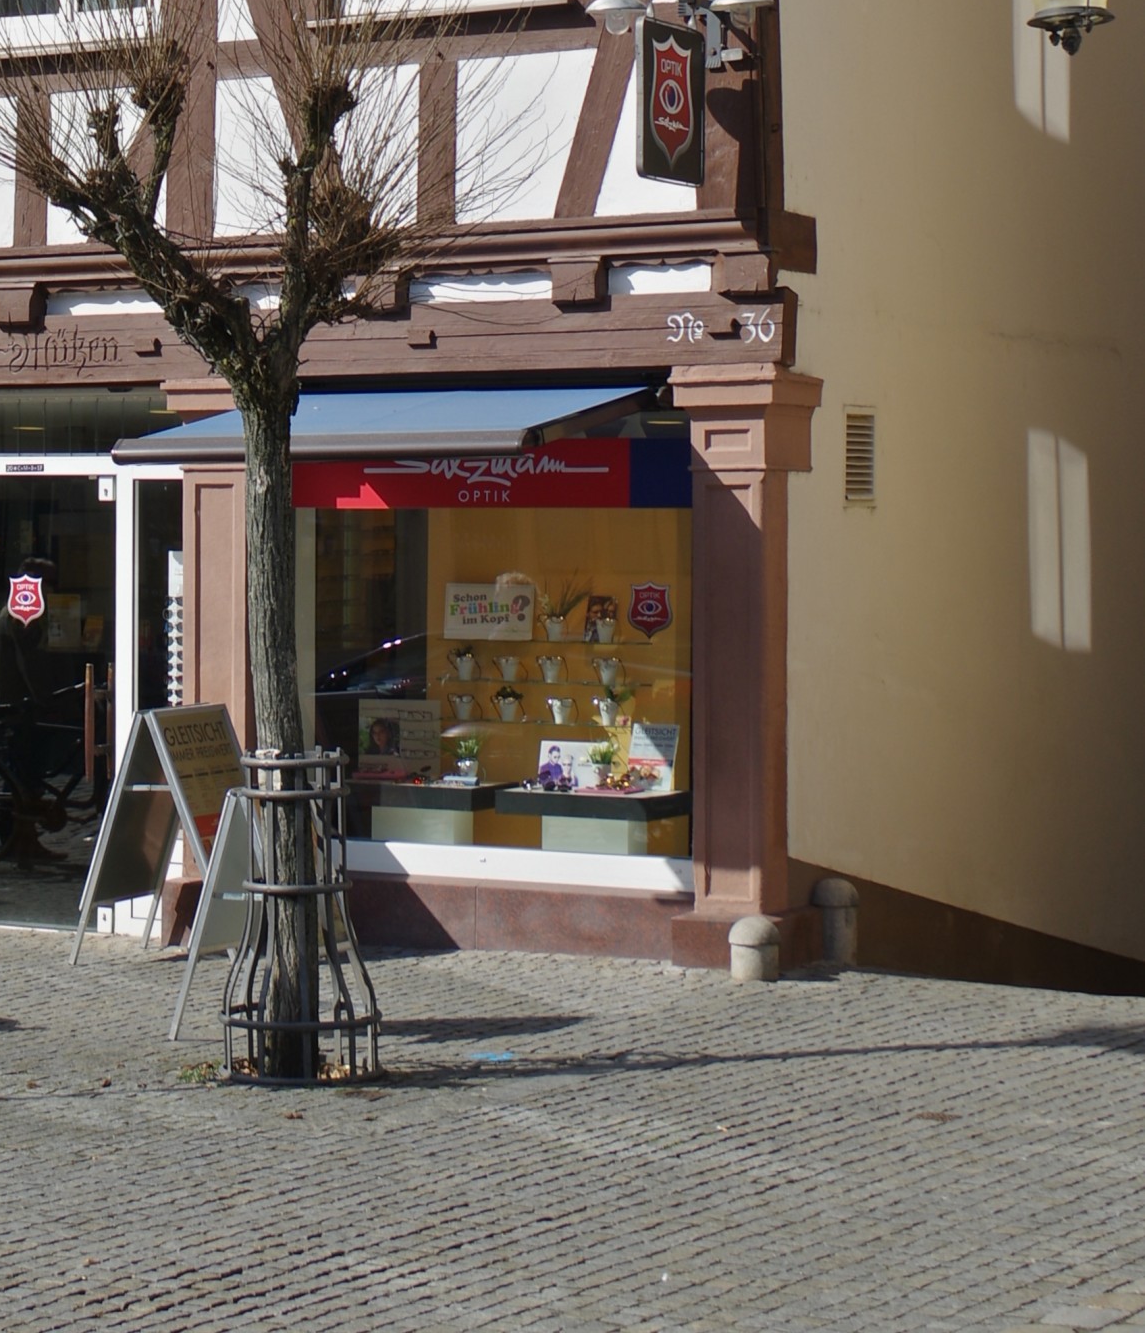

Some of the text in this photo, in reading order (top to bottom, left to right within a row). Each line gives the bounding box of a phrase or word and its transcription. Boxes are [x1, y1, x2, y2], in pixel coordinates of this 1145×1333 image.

[661, 58, 683, 77] OPTIK
[741, 308, 775, 343] 36
[458, 490, 510, 502] OPTIK
[16, 583, 35, 591] OPTIK
[453, 594, 487, 603] Schon
[449, 601, 520, 616] Frühling
[462, 616, 477, 625] im
[481, 613, 510, 624] Kopf
[163, 721, 227, 747] GLEITSICHT
